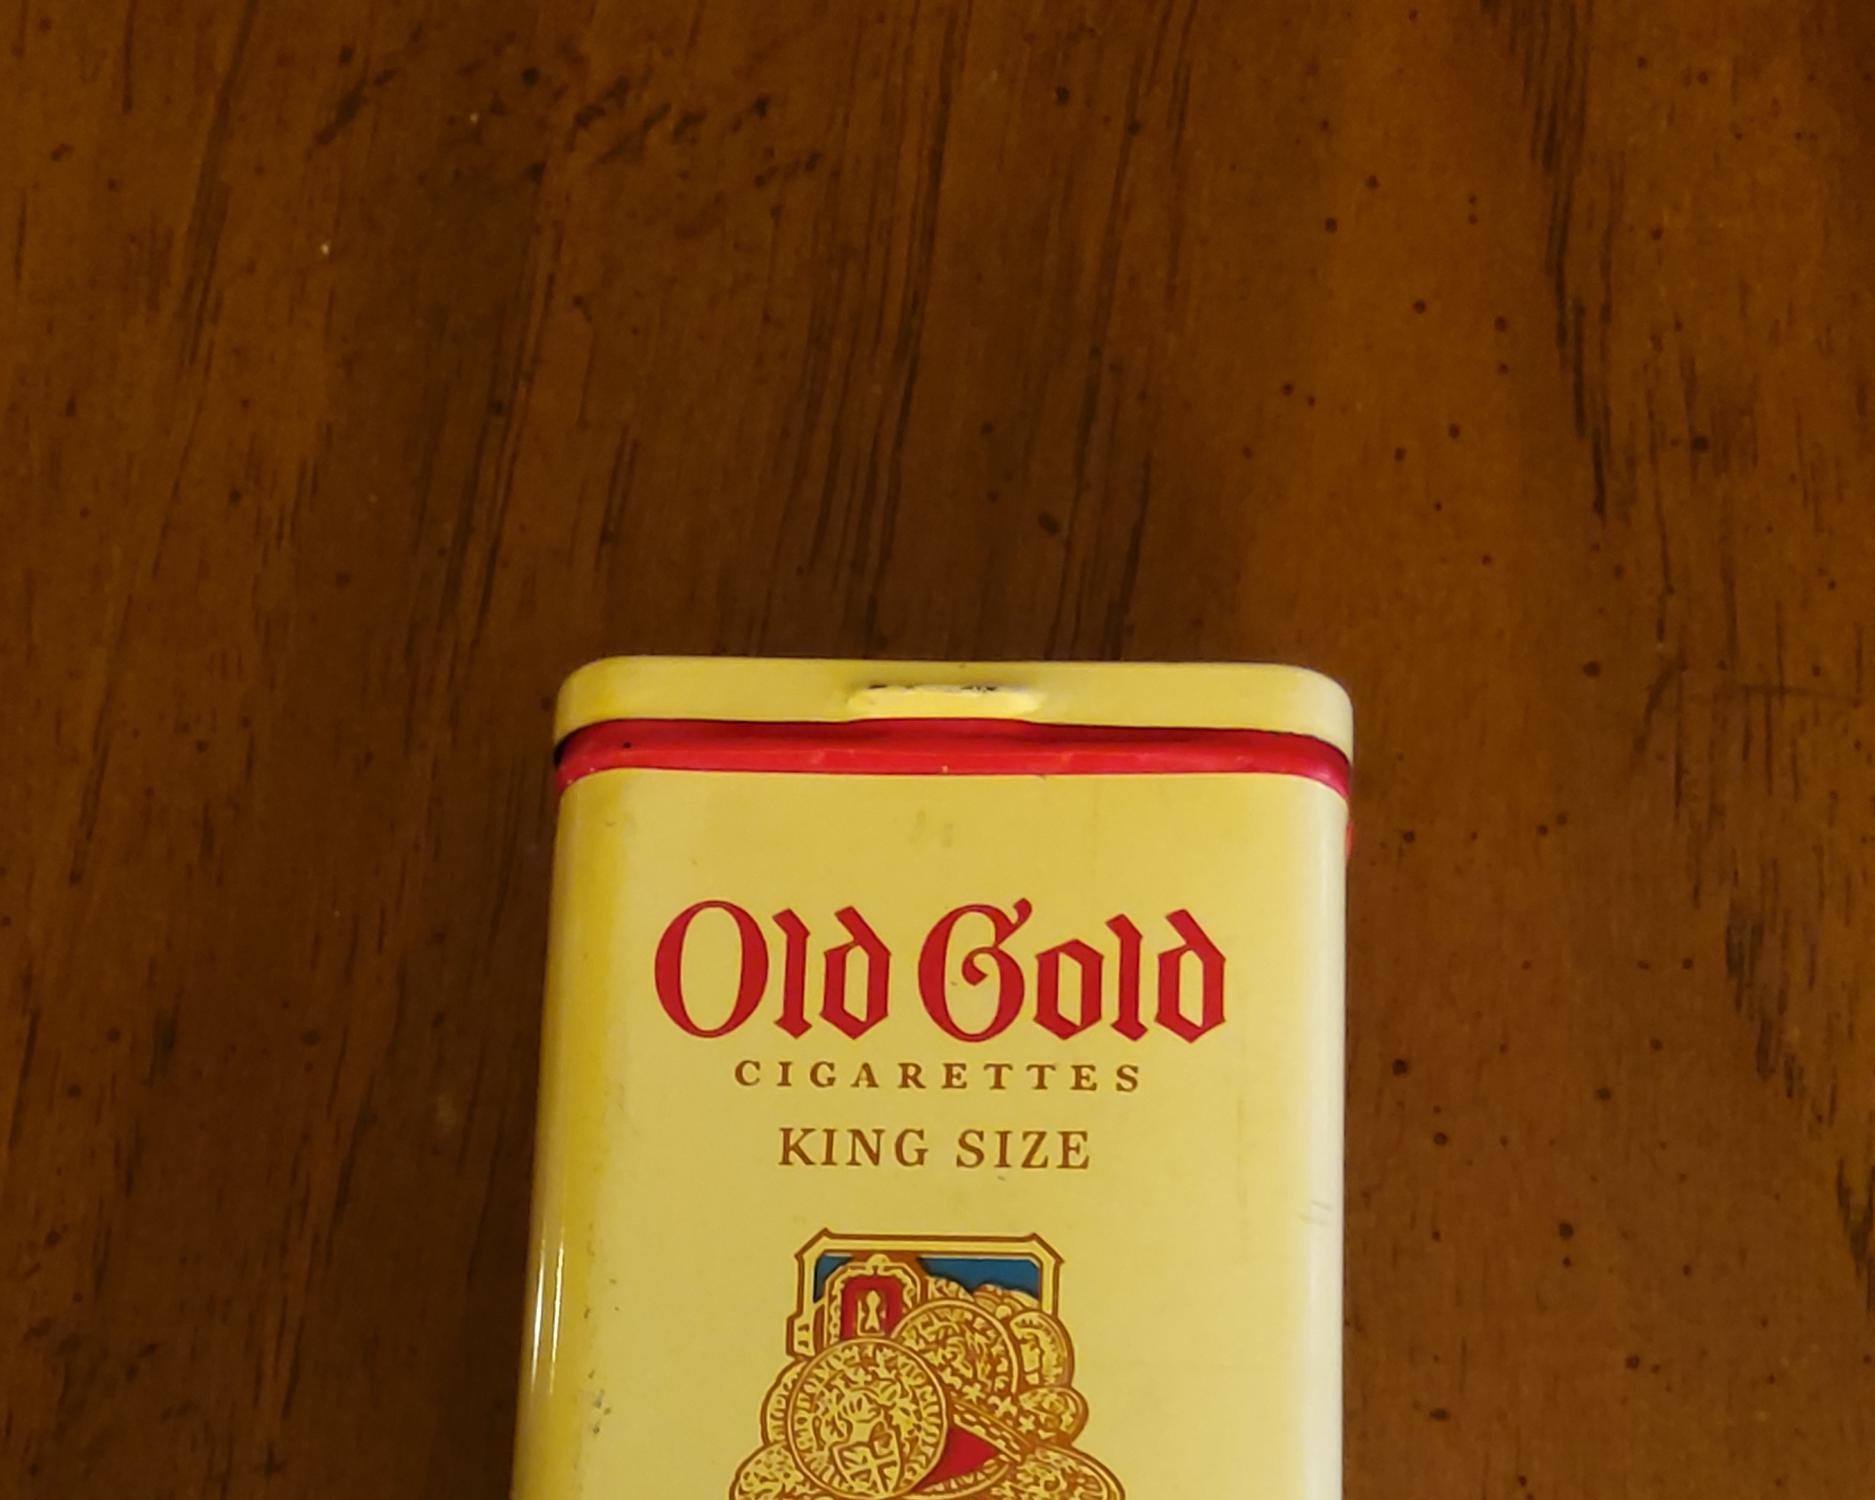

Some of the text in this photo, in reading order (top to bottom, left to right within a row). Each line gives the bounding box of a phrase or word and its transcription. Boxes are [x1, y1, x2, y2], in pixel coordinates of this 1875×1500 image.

[654, 898, 1226, 1043] Old Gold
[734, 1060, 1140, 1092] CIGARETTES
[778, 1127, 1090, 1170] KING SIZE
